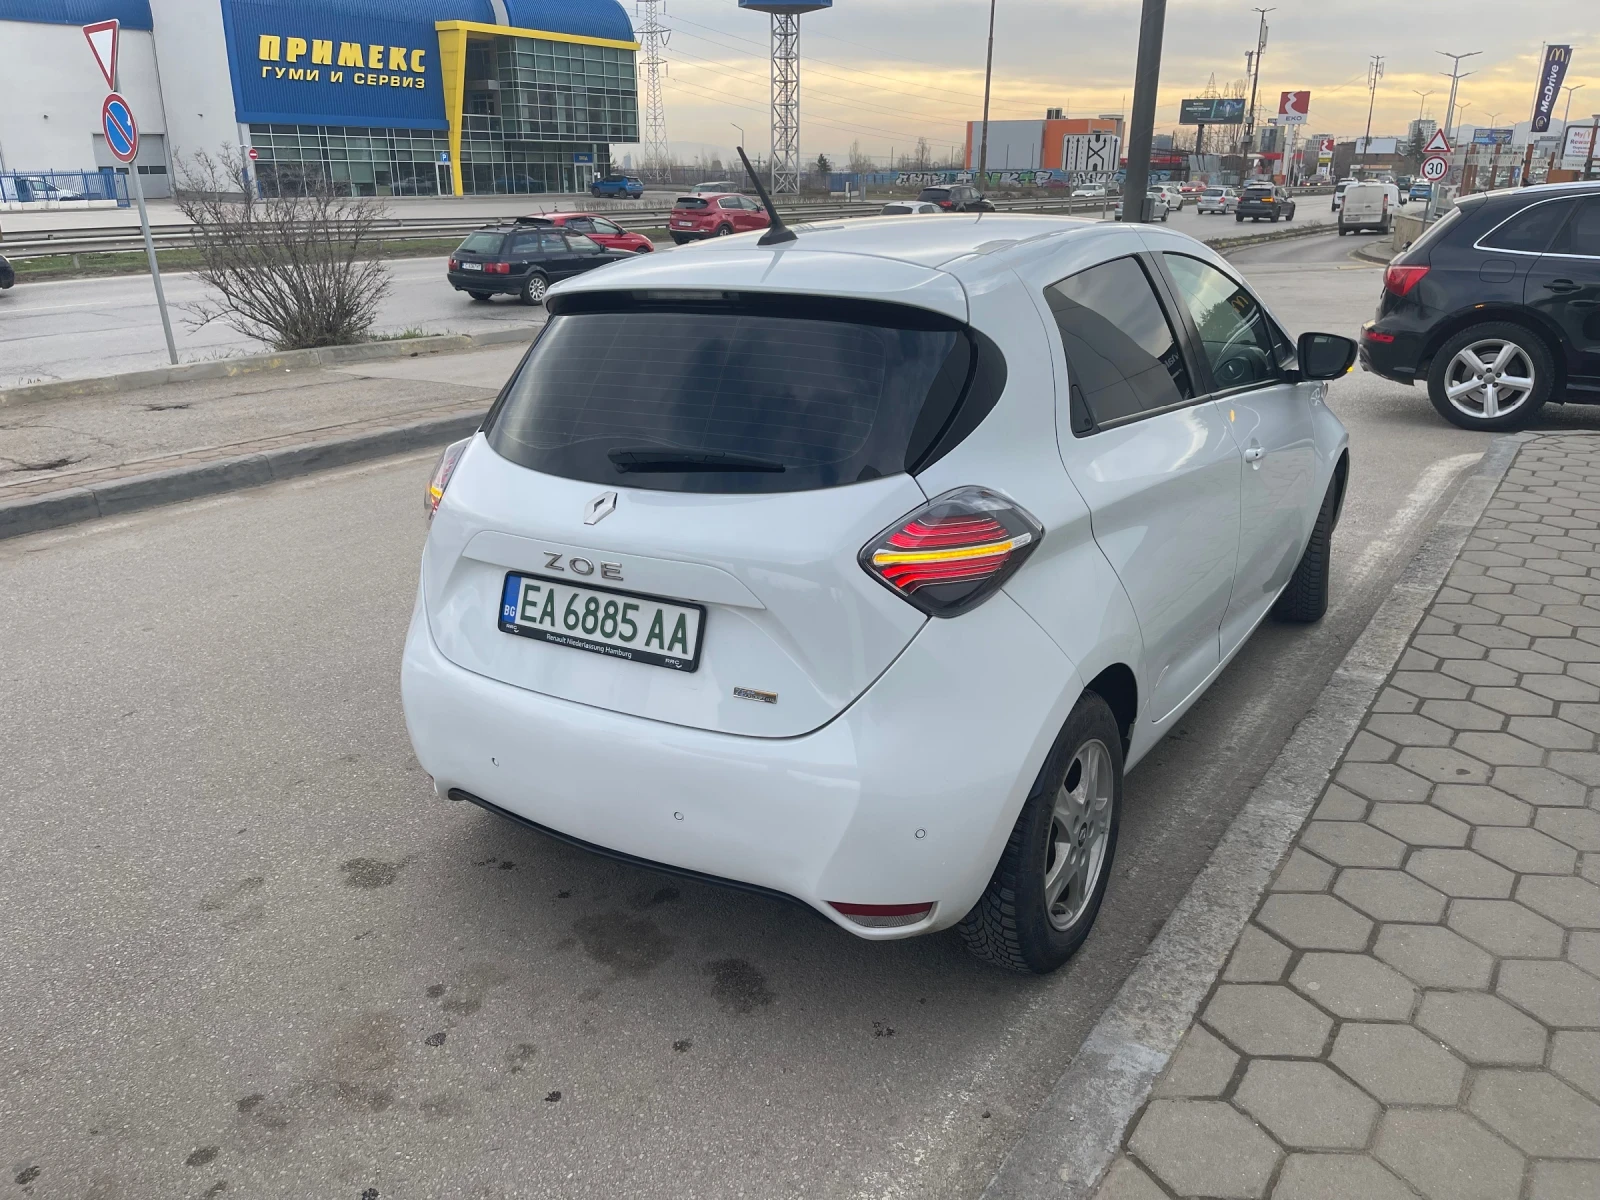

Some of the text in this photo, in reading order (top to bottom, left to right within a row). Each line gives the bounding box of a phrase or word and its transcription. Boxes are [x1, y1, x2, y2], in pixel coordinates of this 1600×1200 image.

[258, 34, 426, 73] ПРИМЕКС
[261, 66, 426, 89] ГУМИ И СЕРВИЗ
[1540, 64, 1559, 113] McDrive
[1427, 162, 1443, 175] 30
[543, 550, 625, 581] ZOE
[503, 604, 516, 617] BG
[520, 584, 688, 655] EA 6885 AA
[546, 633, 632, 659] Renault Niederlassung Hamburg
